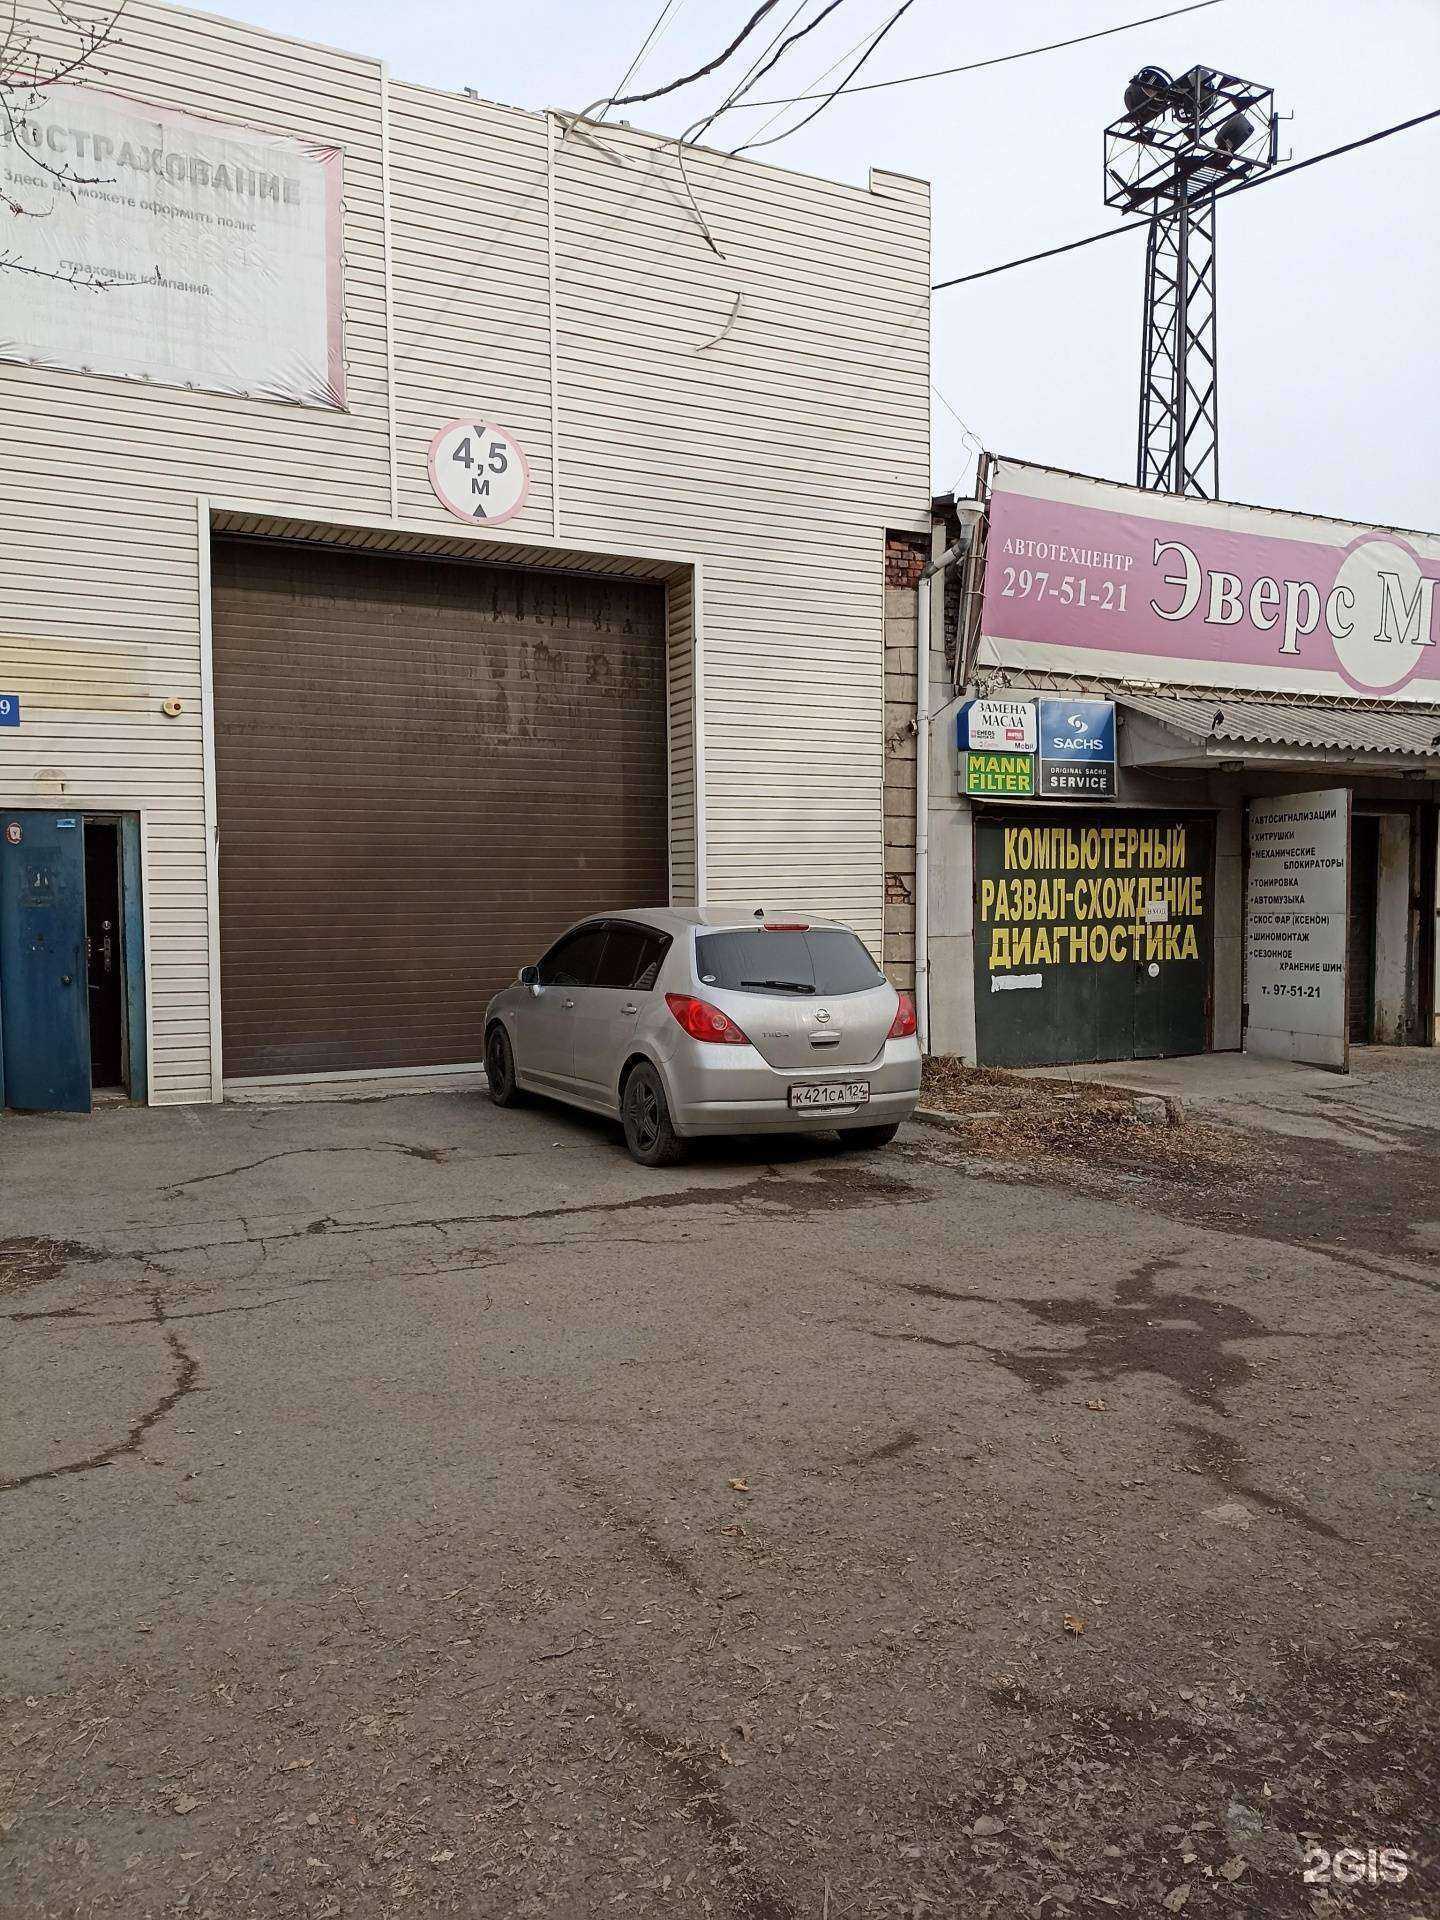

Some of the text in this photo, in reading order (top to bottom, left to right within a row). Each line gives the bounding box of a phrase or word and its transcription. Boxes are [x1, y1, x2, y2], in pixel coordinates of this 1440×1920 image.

[4, 168, 48, 188] Здесь
[78, 188, 136, 207] можете
[140, 200, 213, 220] оформить
[217, 216, 257, 232] полис
[59, 260, 138, 282] страховых
[453, 437, 508, 477] 4,5
[1003, 538, 1133, 571] АВТОТЕХЦЕНТР
[1001, 567, 1128, 612] 297-51-21
[1150, 538, 1440, 655] Эверс М
[979, 702, 1027, 715] ЗАМЕНА
[982, 714, 1024, 728] МАСЛА
[1053, 737, 1104, 750] SACHS
[969, 755, 1031, 774] MANN
[1050, 767, 1107, 776] ORIGINAL SACHS
[969, 773, 1031, 792] FILTER
[1050, 775, 1108, 789] SERVICE
[1254, 809, 1337, 825] АВТОСИГНАЛИЗАЦИИ
[1255, 831, 1296, 842] ХИТРУШКИ
[1004, 823, 1187, 870] КОМПЬЮТЕРНЫЙ
[1255, 847, 1316, 860] МЕХАНИЧЕСКИЕ
[1283, 859, 1345, 871] БЛОКИРАТОРЫ
[1255, 878, 1299, 888] ТОНИРОВКА
[981, 876, 1203, 924] РАЗВАЛ-СХОЖДЕНИЕ
[1254, 895, 1305, 905] АВТОМУЗЫКА
[1253, 915, 1330, 926] СКОС ФАР (КСЕНОН)
[1253, 932, 1310, 942] ШИНОМОНТАЖ
[989, 924, 1199, 970] ДИАГНОСТИКА
[1253, 949, 1293, 959] СЕЗОННОЕ
[1279, 962, 1342, 973] ХРАНЕНИЕ ШИН
[1273, 984, 1321, 998] 97-51-21
